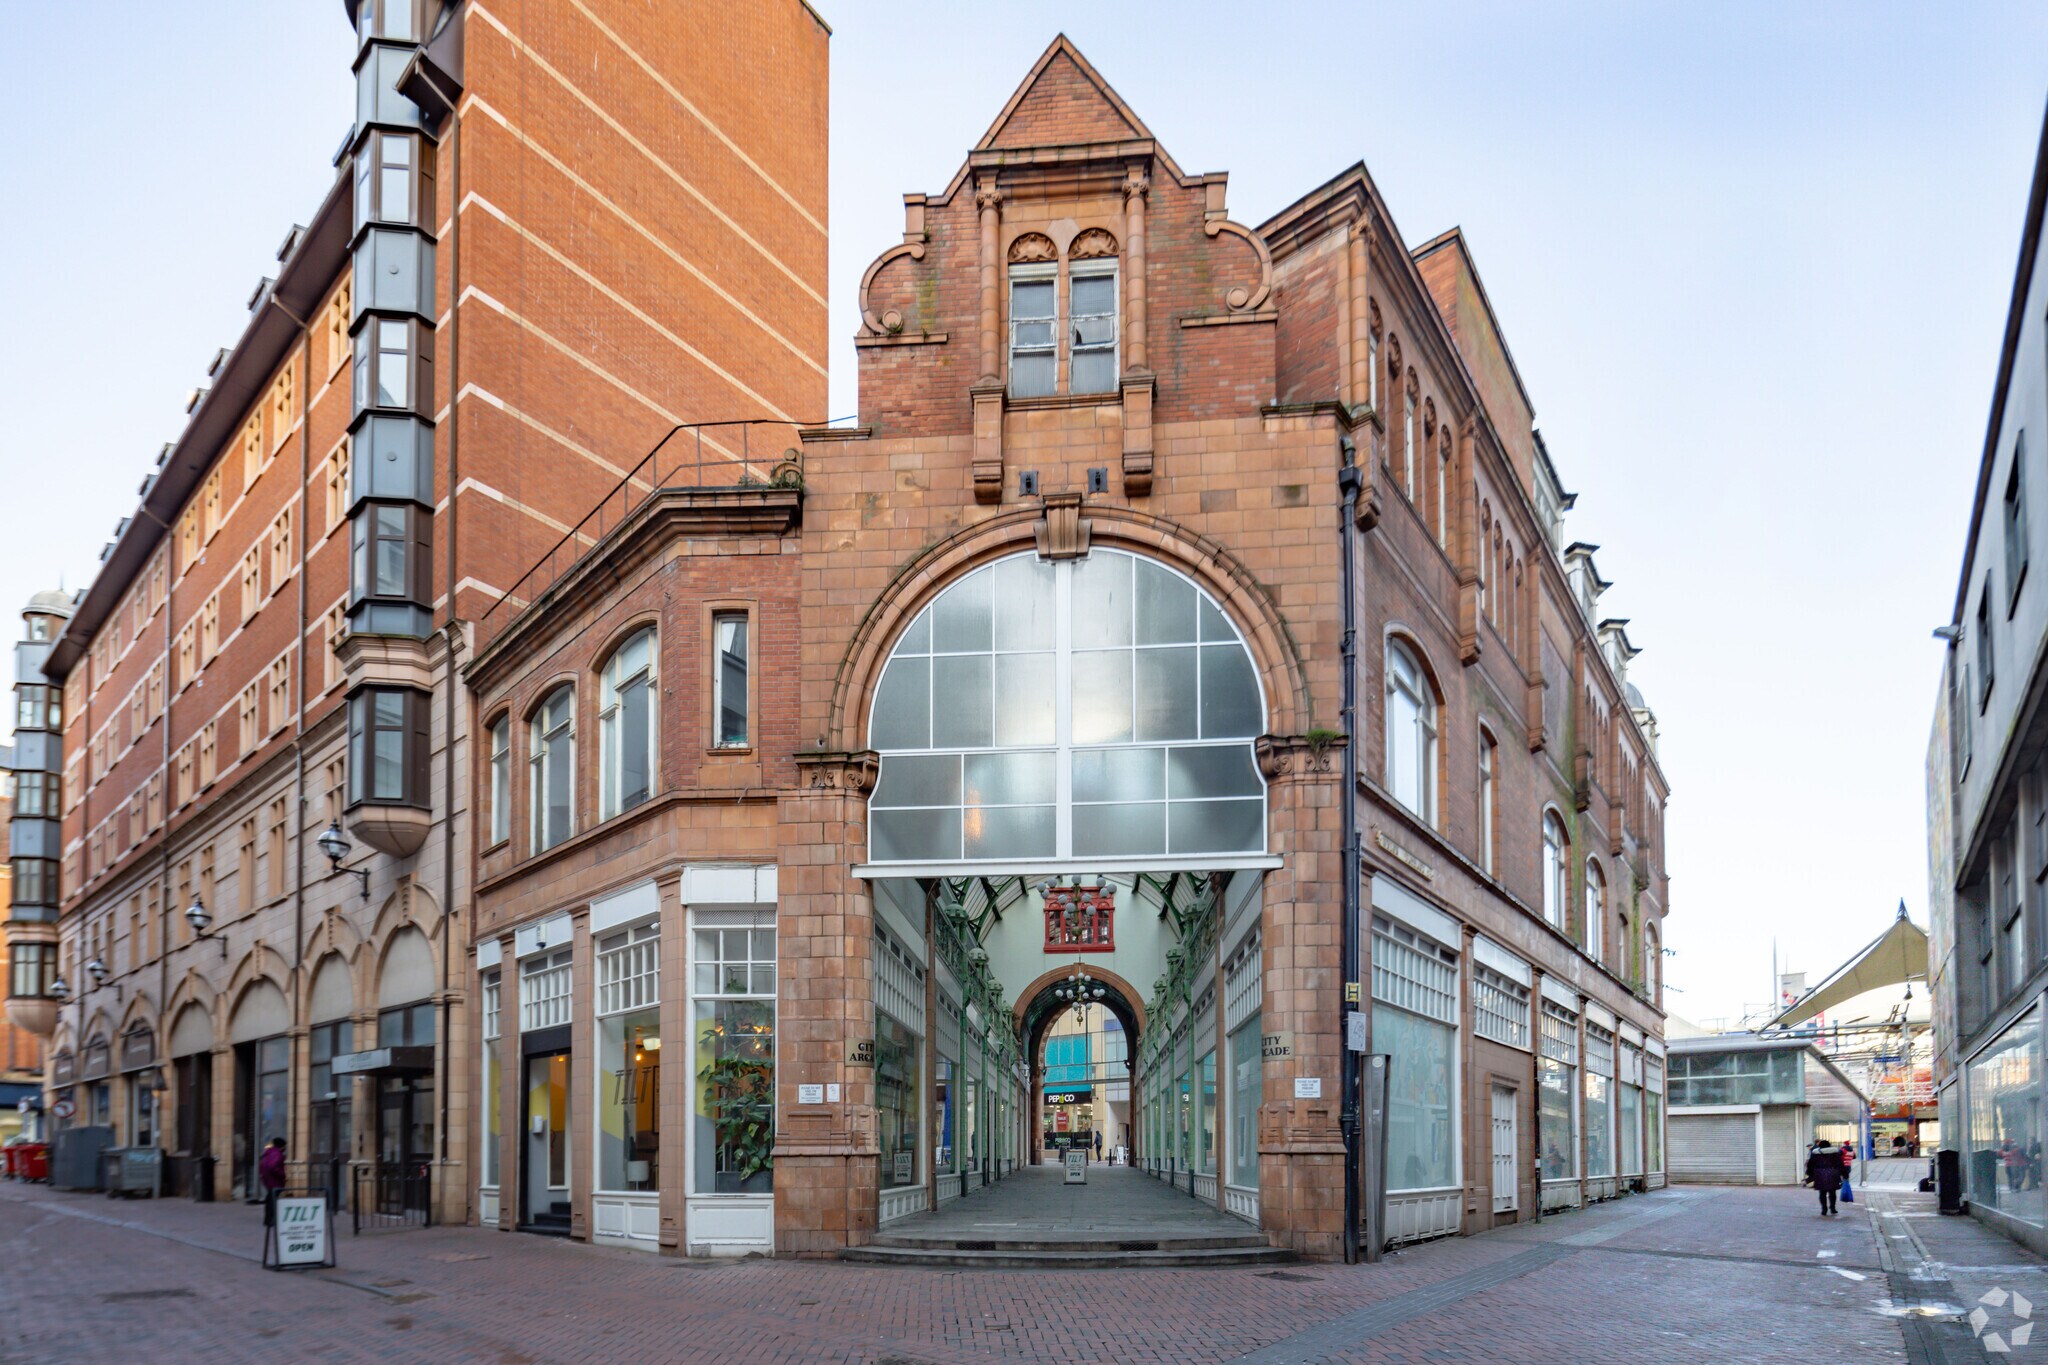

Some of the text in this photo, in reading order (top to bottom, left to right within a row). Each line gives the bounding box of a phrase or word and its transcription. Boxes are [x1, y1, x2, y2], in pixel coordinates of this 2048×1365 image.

[1347, 984, 1359, 1000] H
[613, 1066, 652, 1105] TILT
[283, 1205, 321, 1222] TILT
[288, 1243, 315, 1253] OPEN
